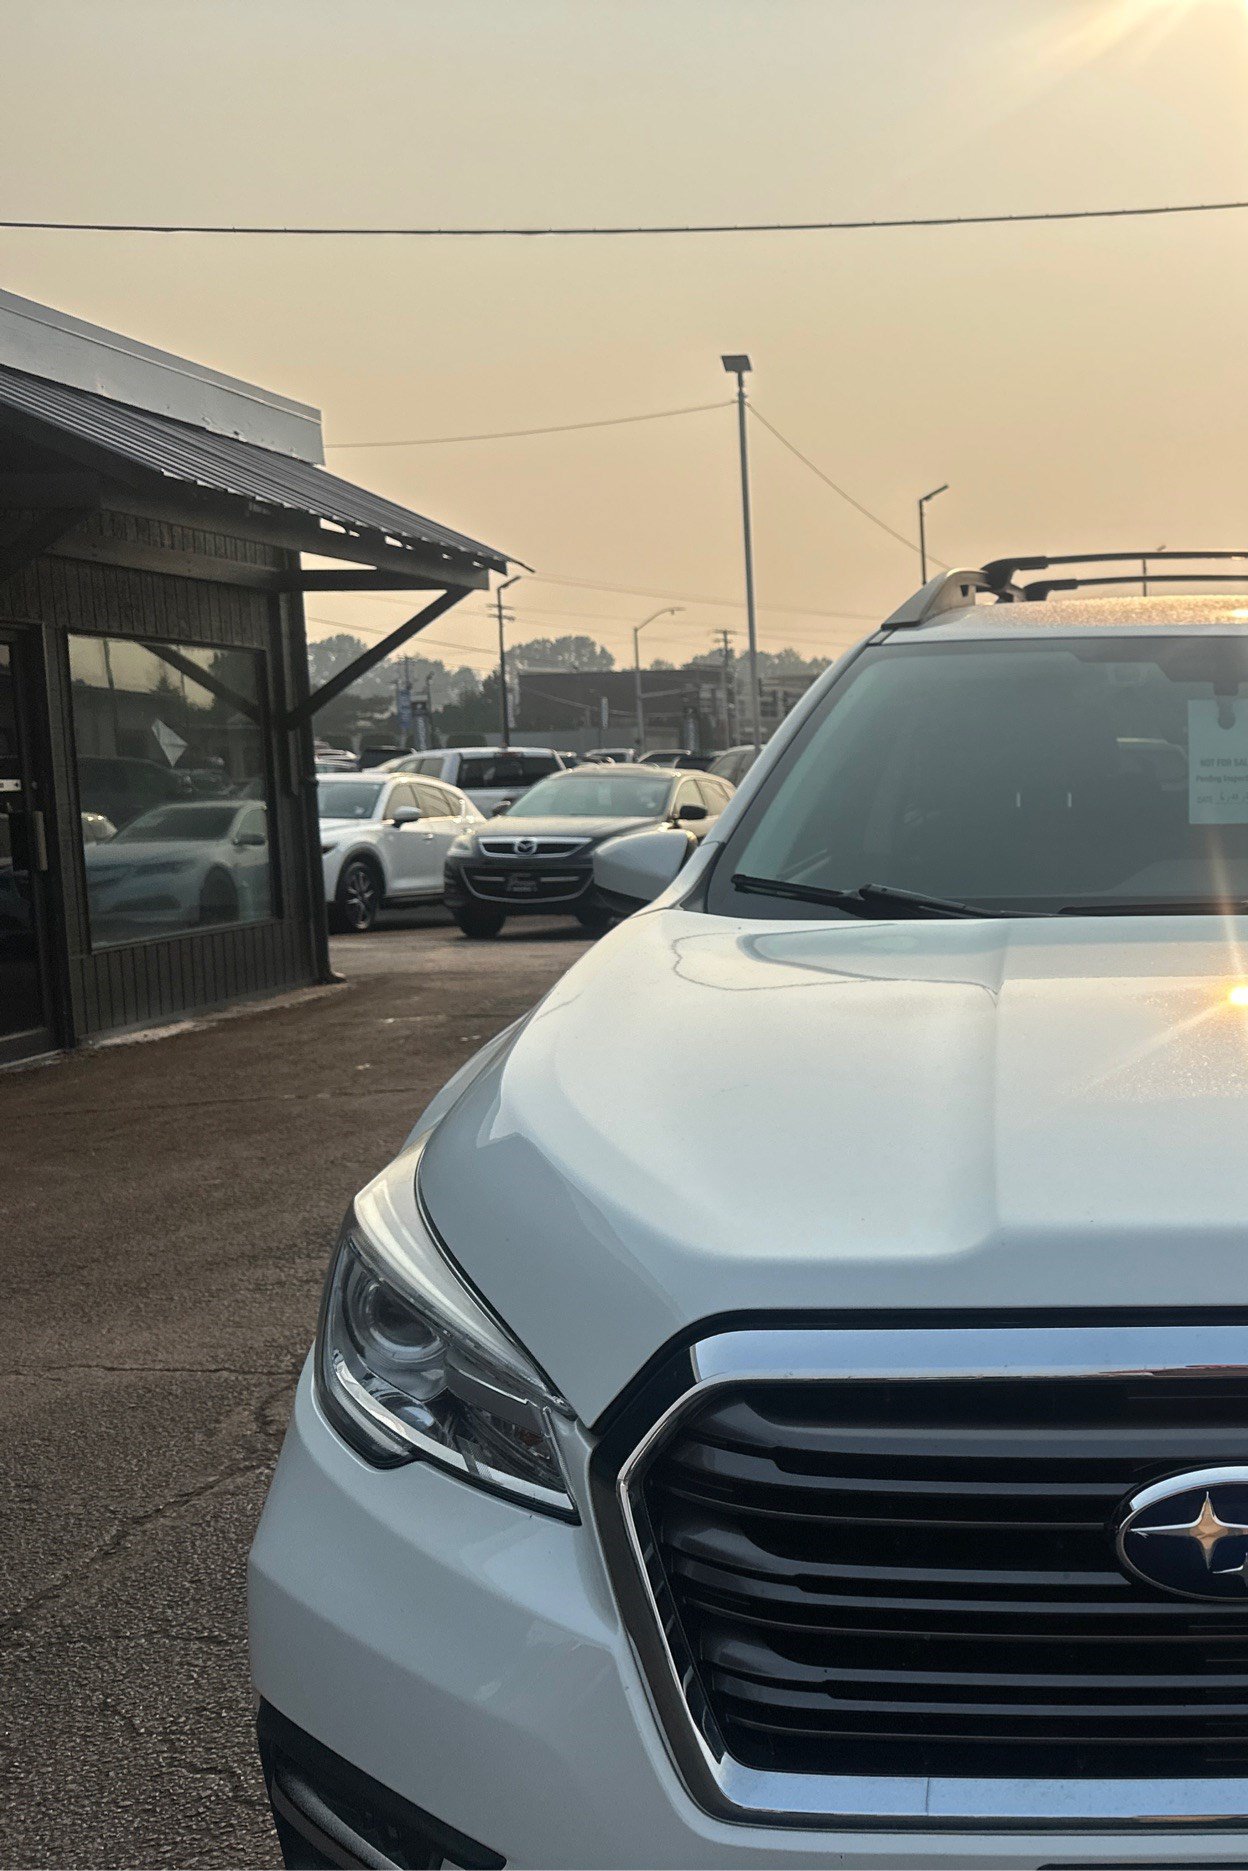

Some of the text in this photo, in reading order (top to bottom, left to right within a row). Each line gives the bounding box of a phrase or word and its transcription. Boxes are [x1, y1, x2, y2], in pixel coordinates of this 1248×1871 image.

[1199, 758, 1215, 767] NOT
[1216, 758, 1232, 767] FOR
[1195, 774, 1222, 784] Pending
